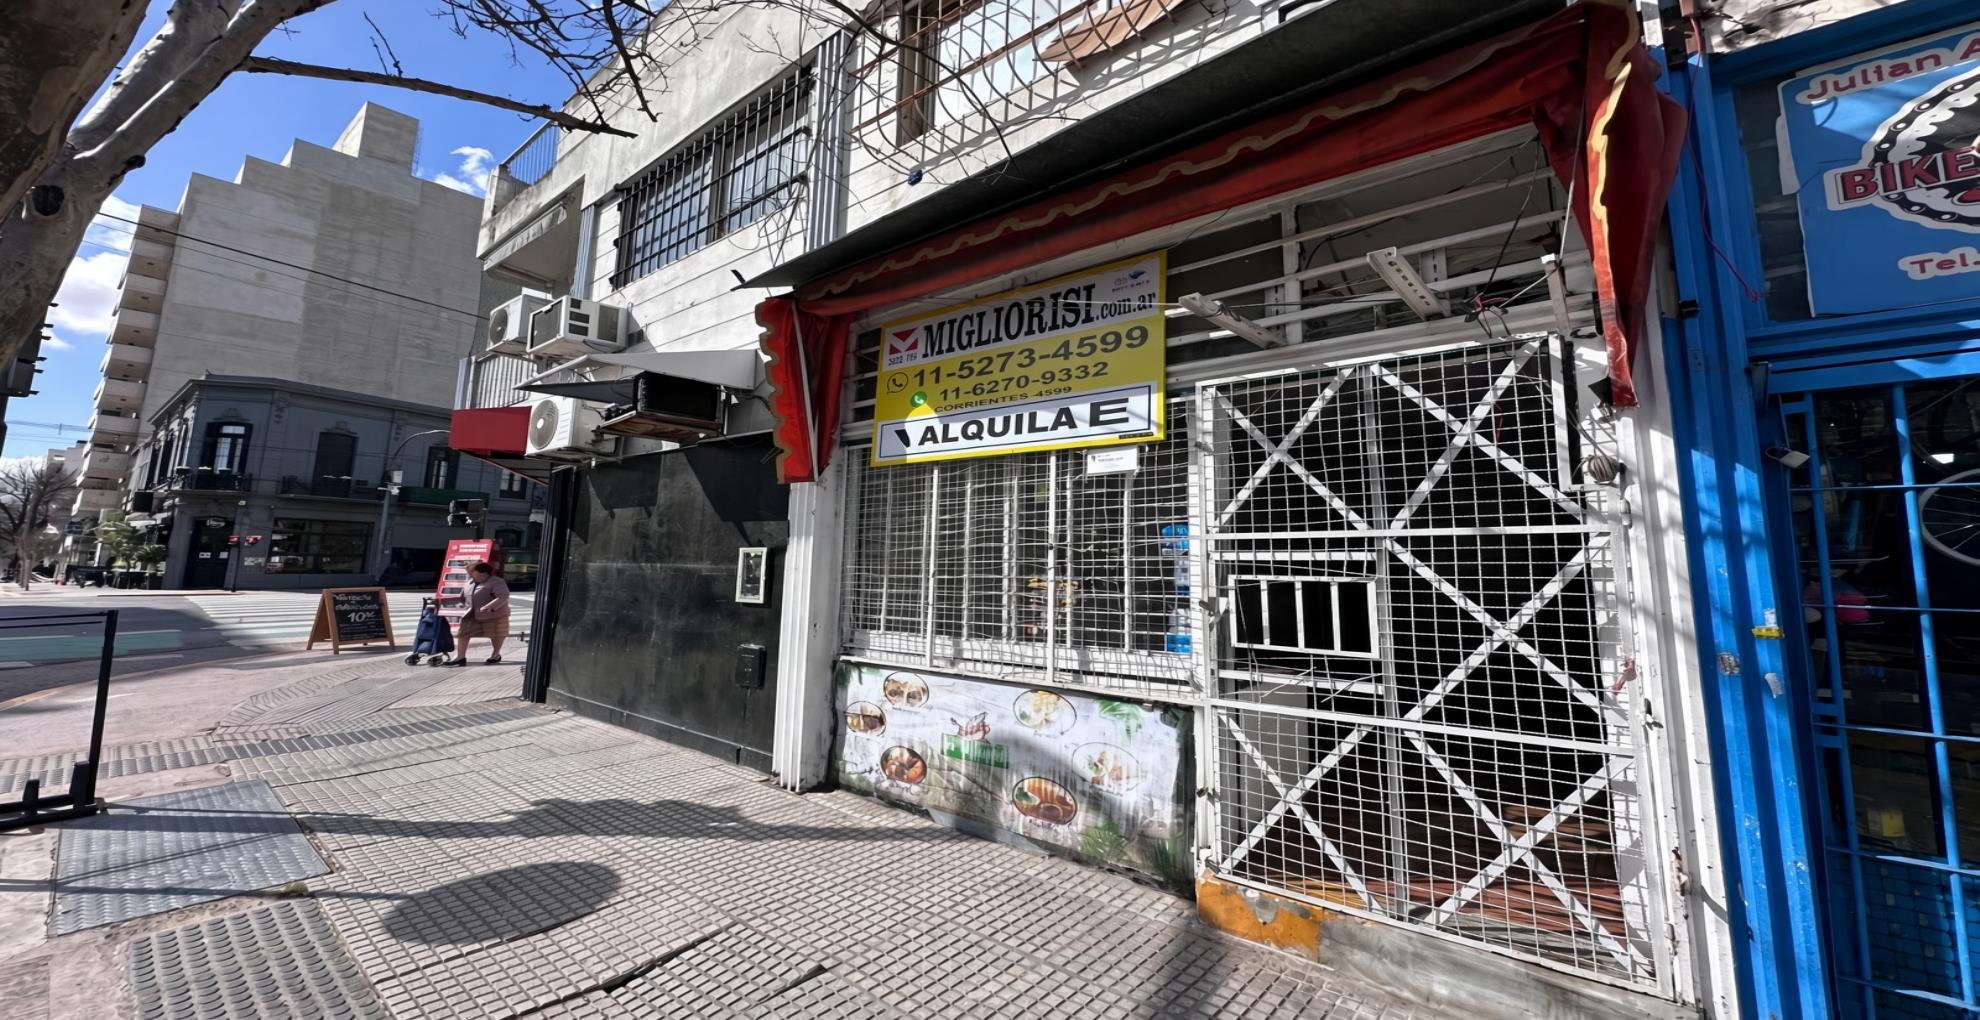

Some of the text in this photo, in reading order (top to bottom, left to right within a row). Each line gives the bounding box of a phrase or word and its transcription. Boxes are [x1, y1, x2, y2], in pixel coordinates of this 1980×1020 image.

[1806, 52, 1941, 100] Julian
[913, 325, 1150, 388] 11-5273-4599
[940, 361, 1109, 402] 11-6270-9332
[934, 392, 1028, 414] CORRIENTES
[918, 406, 1077, 447] ALQUILA
